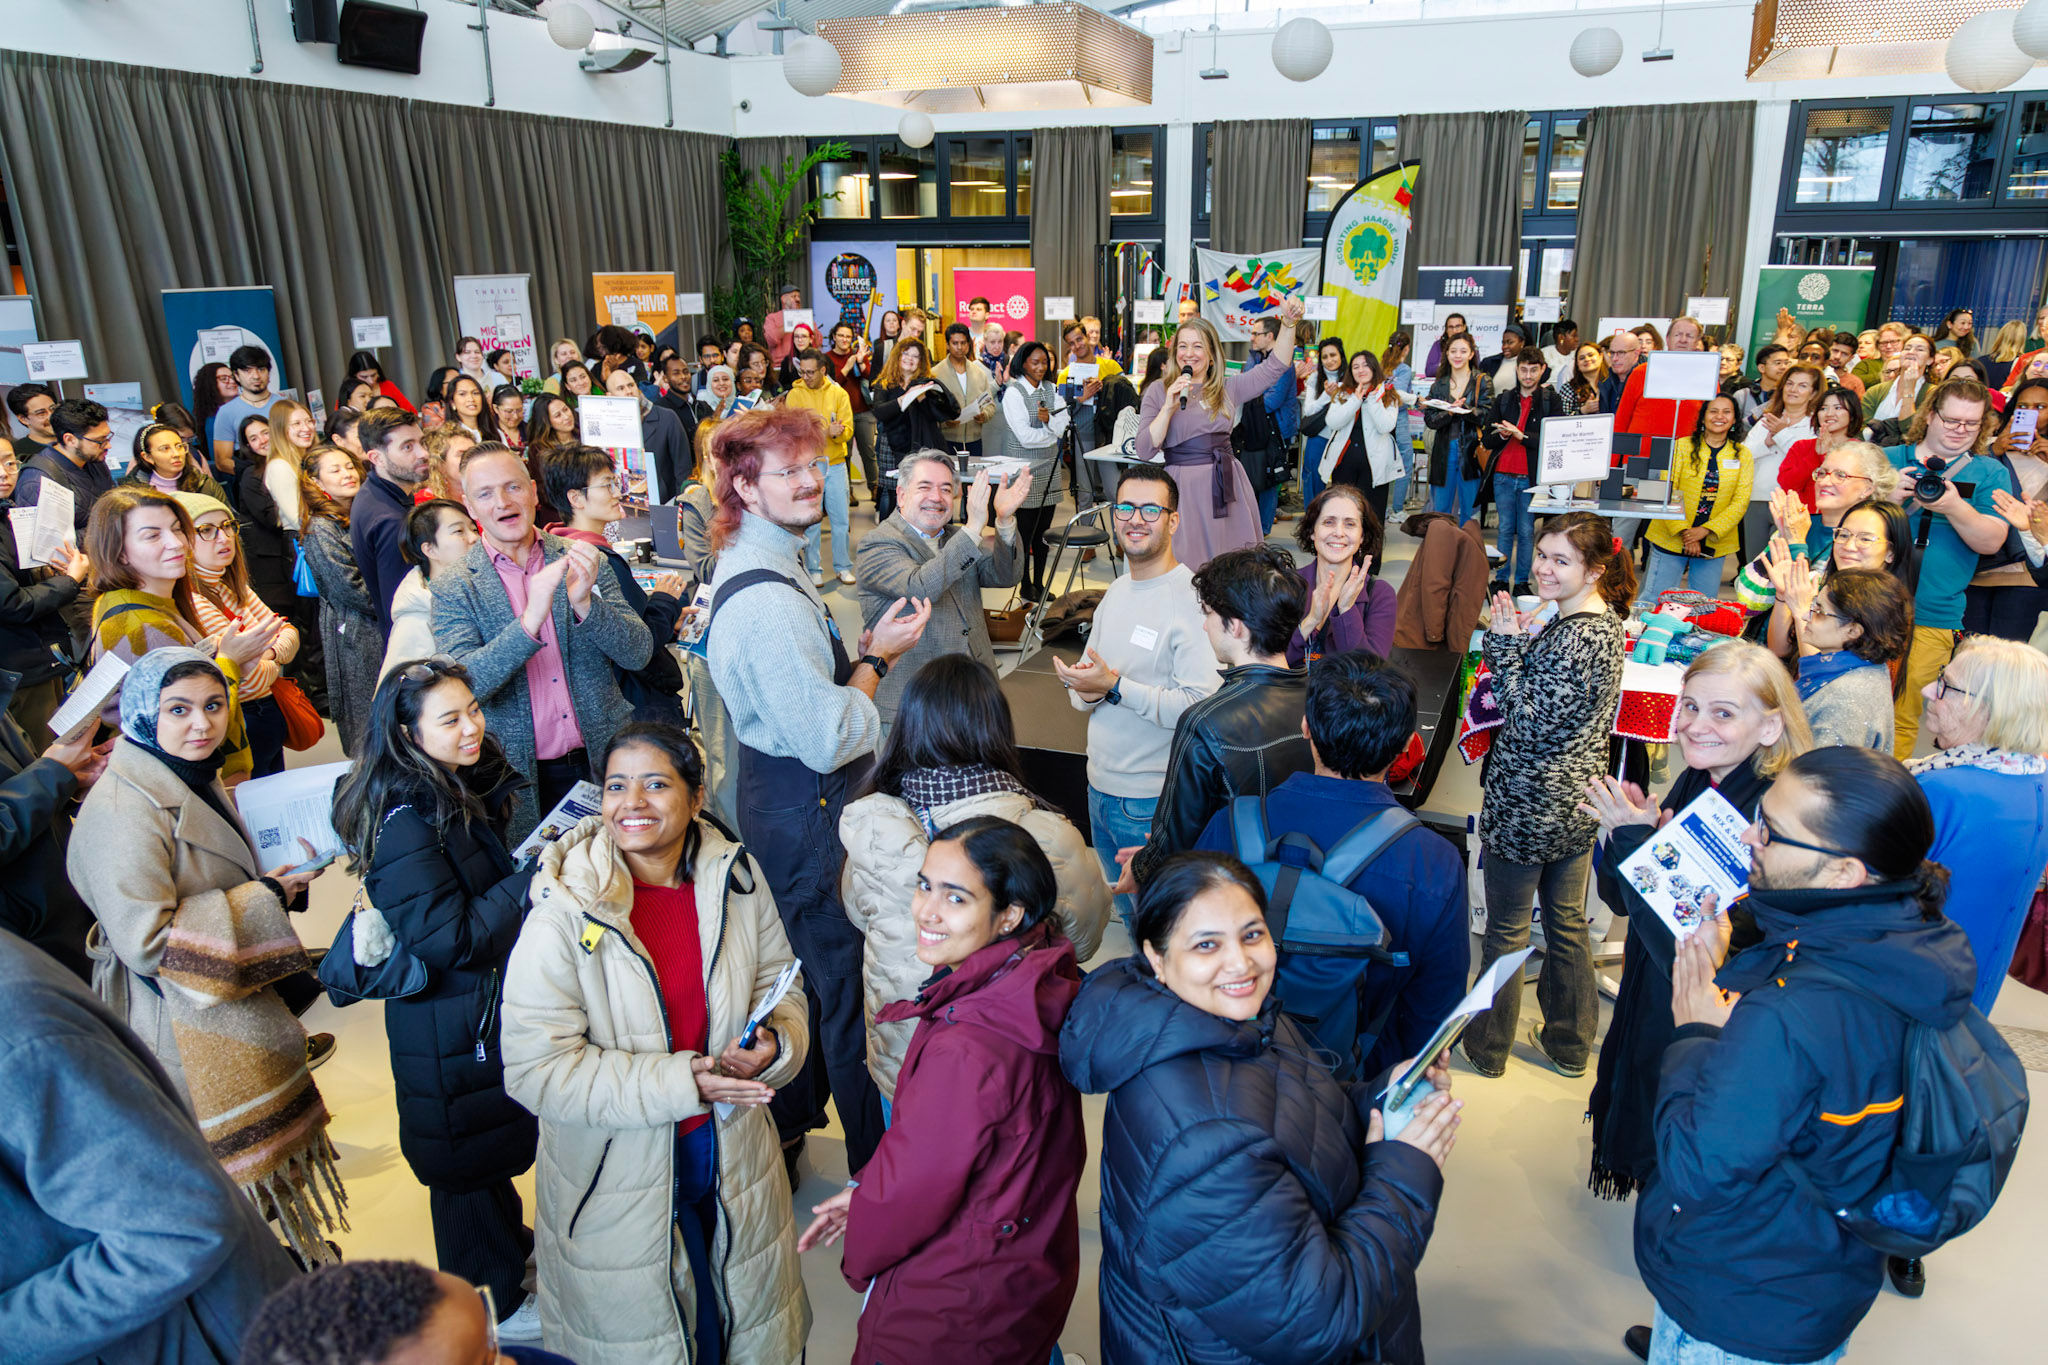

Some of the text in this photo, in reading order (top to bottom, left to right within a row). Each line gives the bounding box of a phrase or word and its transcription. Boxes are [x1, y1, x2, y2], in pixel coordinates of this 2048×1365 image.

[1336, 215, 1400, 266] SCOUTING HAAGSE HOUT
[832, 278, 871, 286] LE REFUGE
[1445, 278, 1467, 286] SOUL
[475, 287, 516, 295] THRIVE
[1444, 285, 1484, 294] SURFERS
[959, 300, 1005, 313] Roact
[1796, 303, 1825, 311] TERRA
[1421, 324, 1439, 332] Doe
[1475, 324, 1499, 332] word
[1711, 813, 1725, 827] MIX
